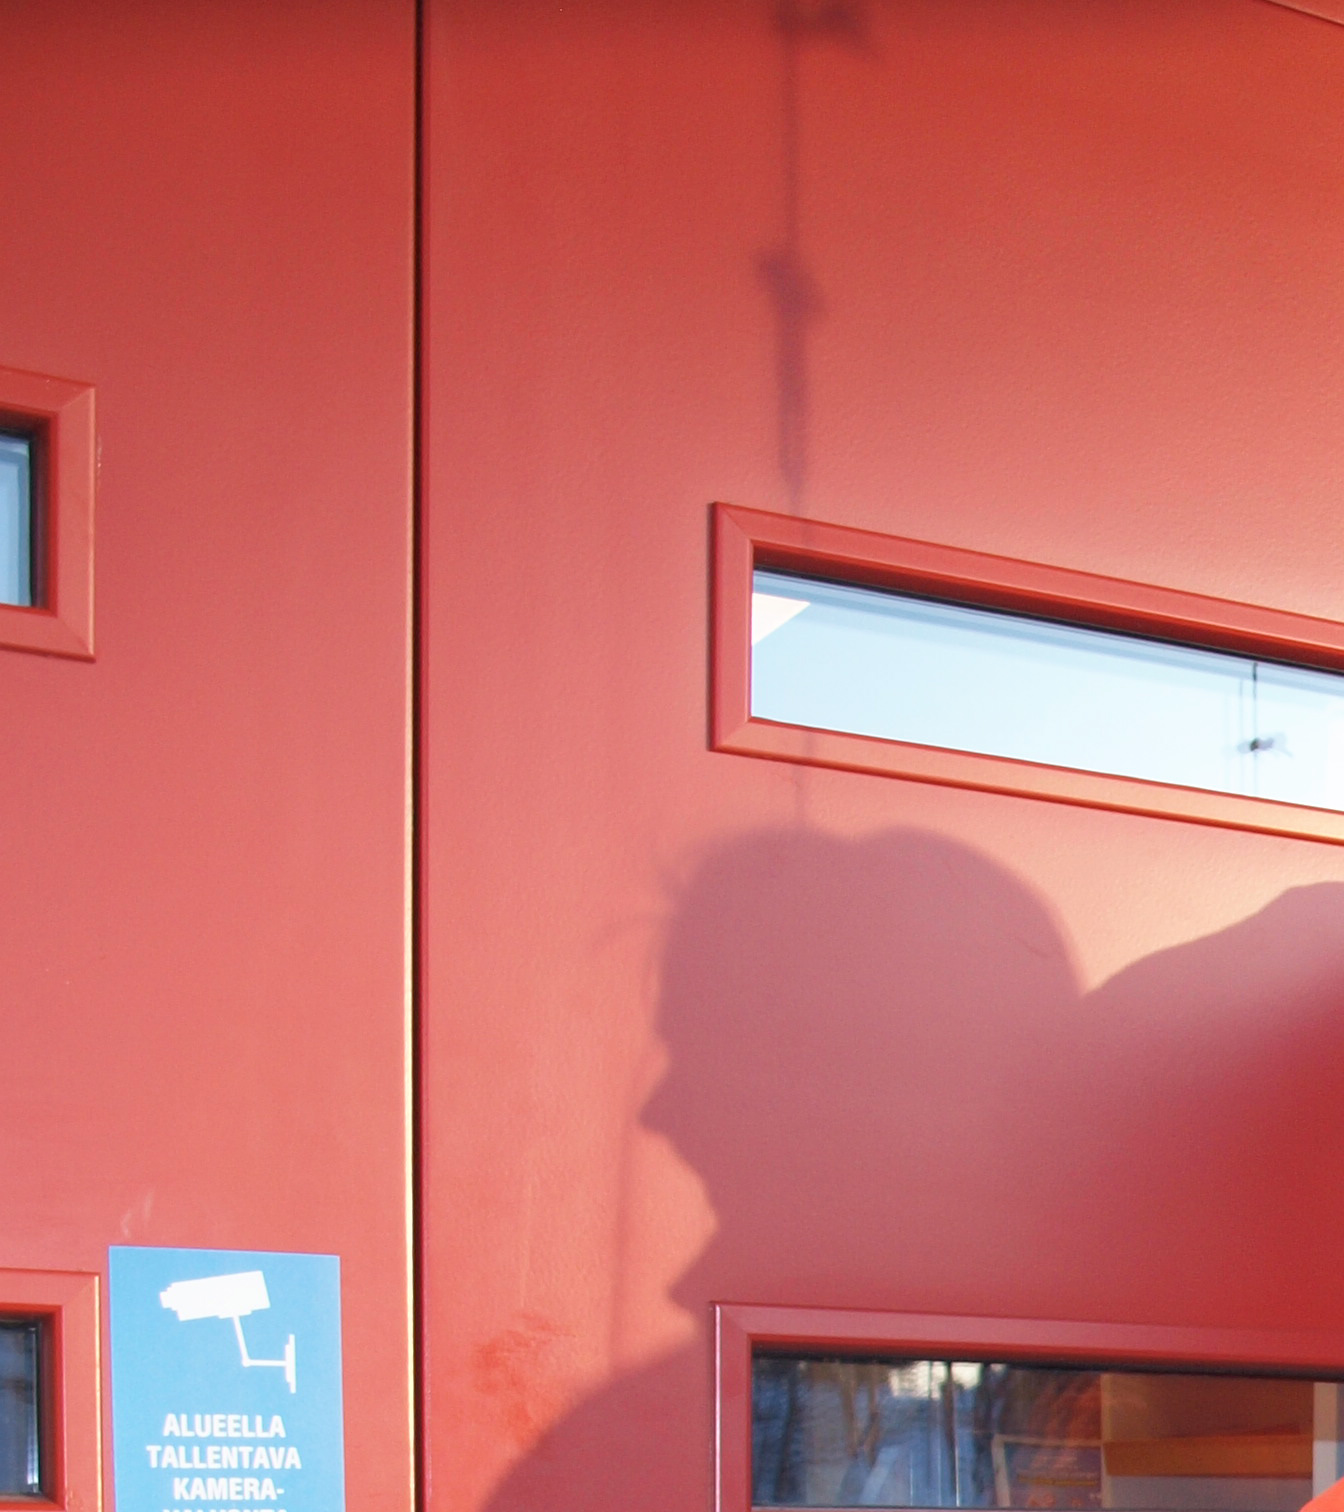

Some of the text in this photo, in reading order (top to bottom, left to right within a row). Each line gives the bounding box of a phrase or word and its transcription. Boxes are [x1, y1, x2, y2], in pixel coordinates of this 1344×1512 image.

[163, 1413, 286, 1438] ALUEELLA
[146, 1445, 301, 1469] TALLENTAVA
[173, 1477, 285, 1500] KAMERA-
